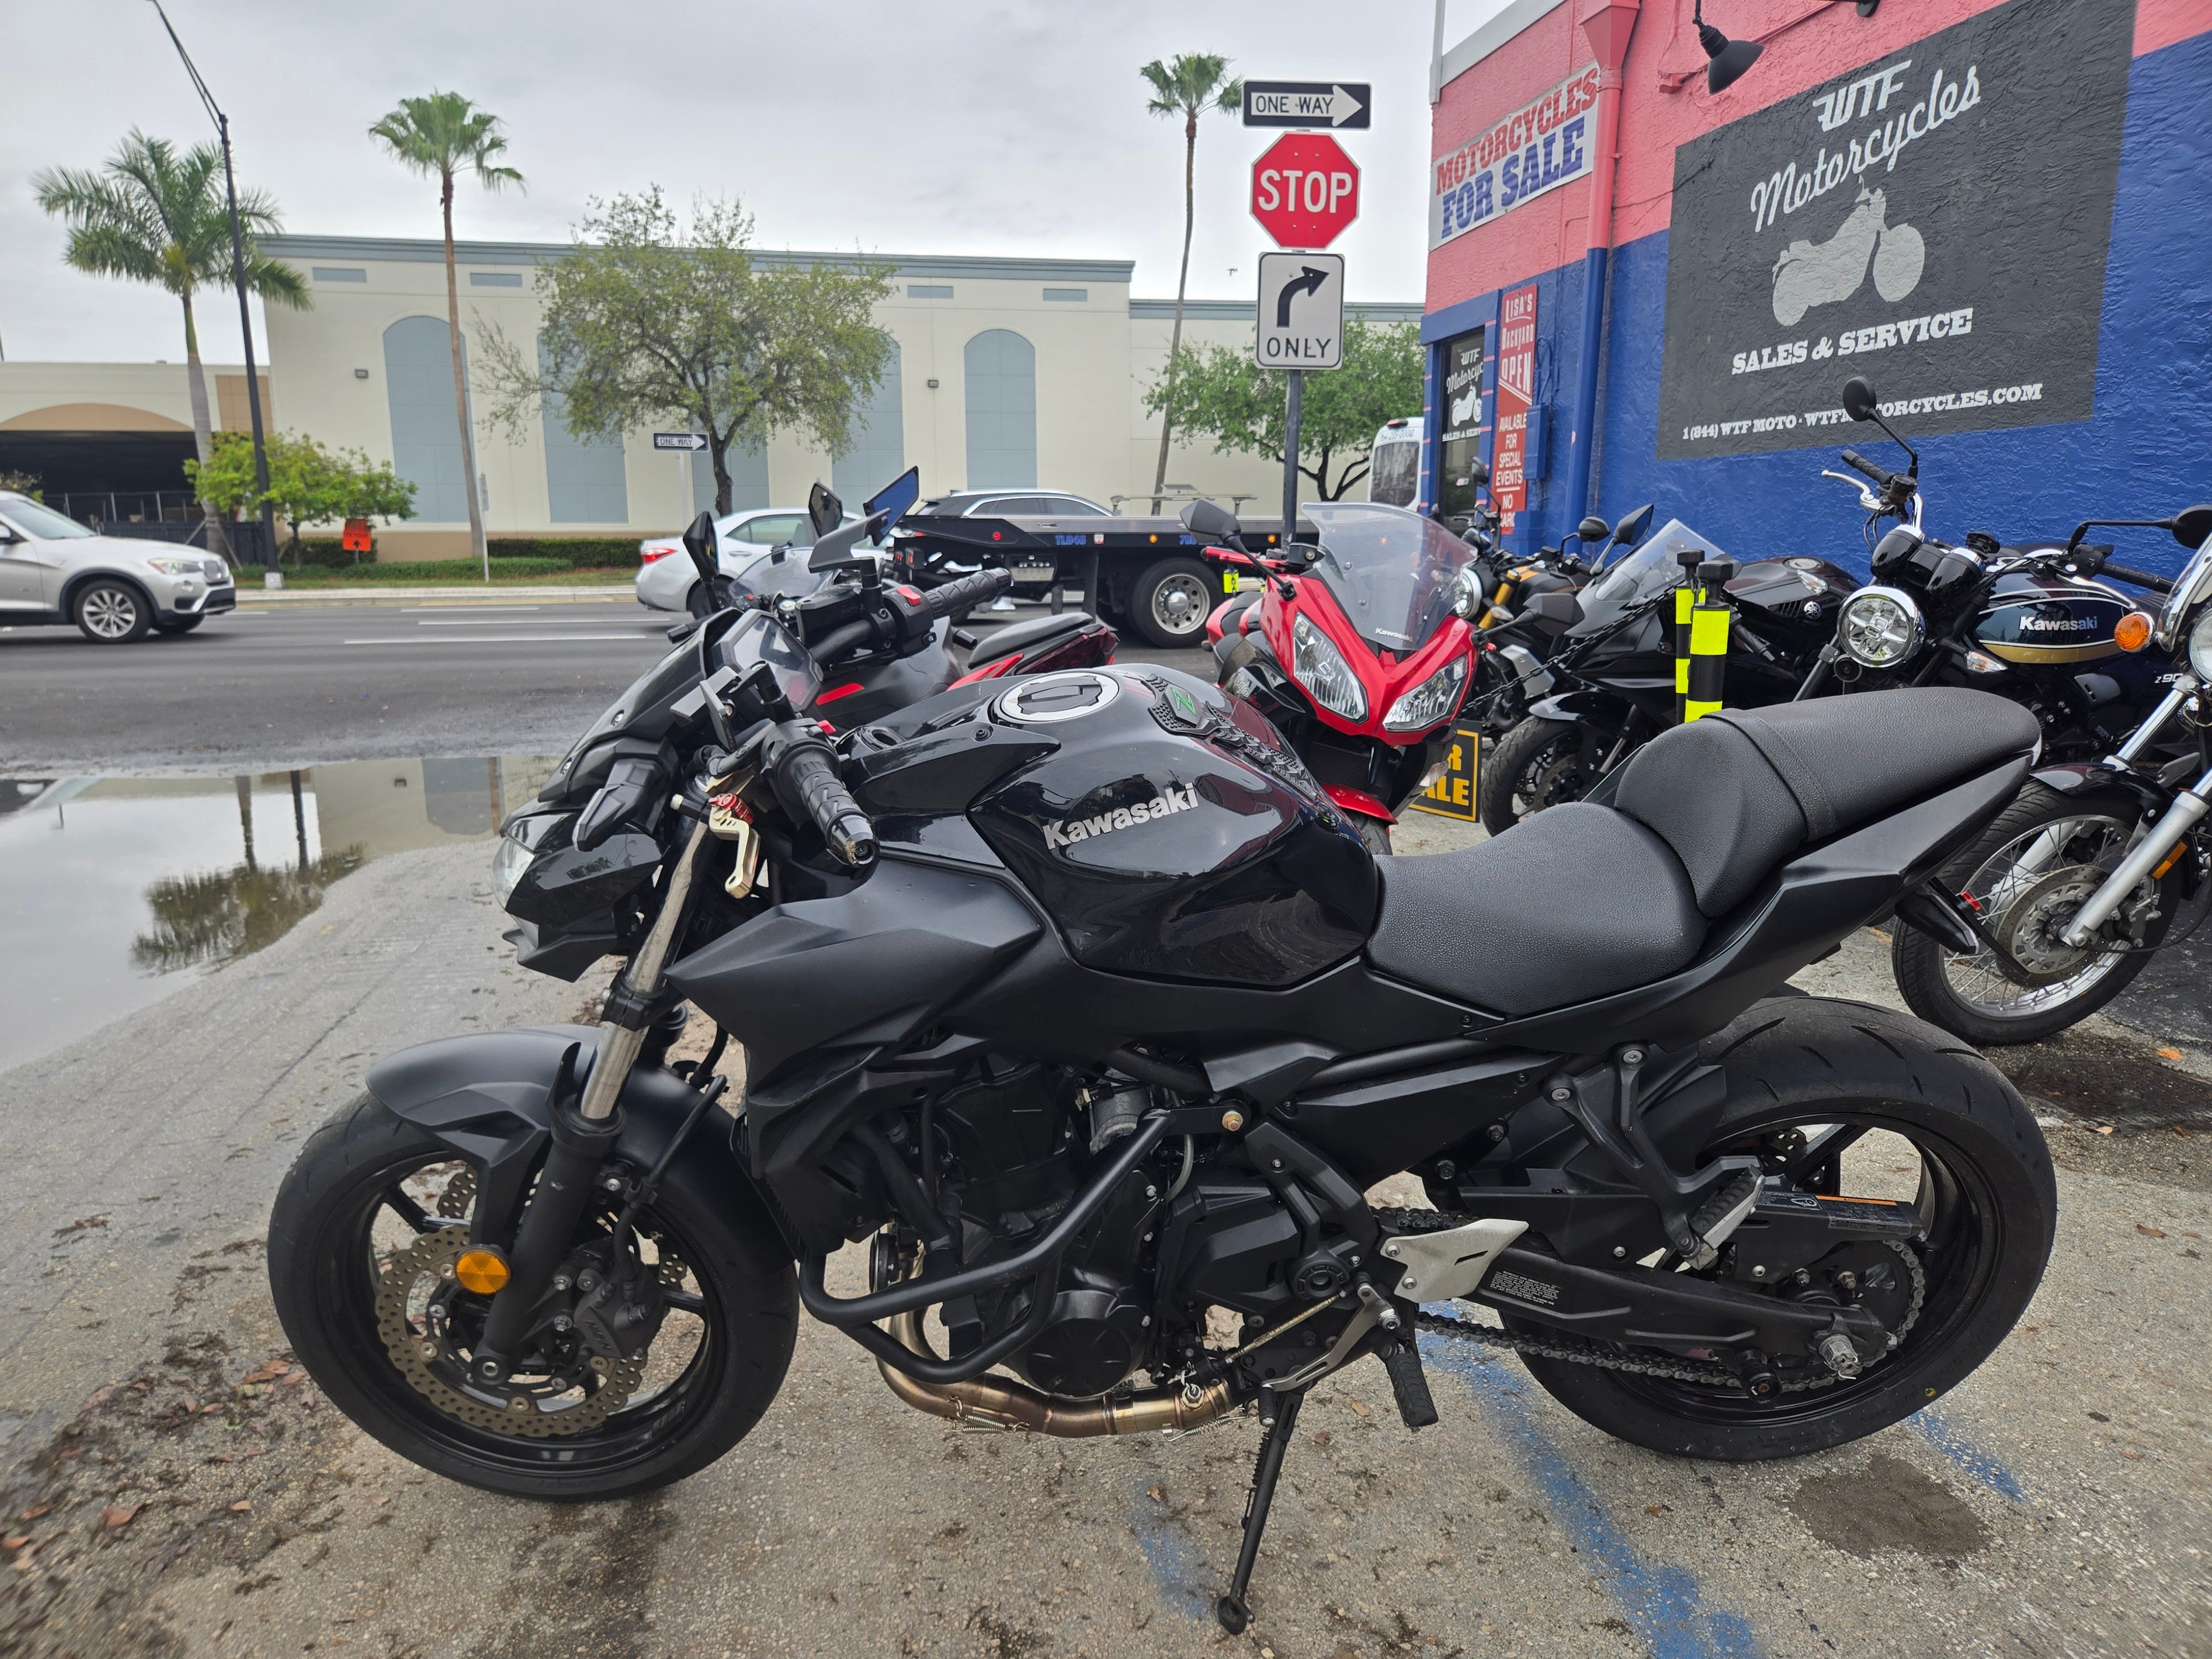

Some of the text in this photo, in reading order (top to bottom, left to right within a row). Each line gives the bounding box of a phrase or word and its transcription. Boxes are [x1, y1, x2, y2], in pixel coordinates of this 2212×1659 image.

[1256, 96, 1333, 114] ONE WAY
[1812, 60, 1912, 132] WTF
[1436, 68, 1597, 196] MOTORCYCLES
[1750, 65, 1980, 233] Motorcycles
[1442, 116, 1585, 239] FOR SALE
[1258, 169, 1353, 213] STOP
[1505, 293, 1532, 323] LISA'S
[1267, 337, 1332, 358] ONLY
[1731, 307, 1973, 375] SALES & SERVICE
[1458, 348, 1481, 365] WTF
[1501, 352, 1531, 394] OPEN
[1499, 413, 1527, 432] AVAILABLE
[1682, 426, 1689, 440] 1
[1690, 424, 1719, 441] (844)
[1720, 420, 1752, 435] WTF
[1752, 415, 1797, 432] MOTO
[1442, 431, 1460, 442] SALES
[1505, 434, 1517, 449] FOR
[1499, 451, 1521, 468] SPECIAL
[1496, 469, 1523, 486] EVENTS
[1503, 494, 1513, 509] NO
[2019, 616, 2098, 631] Kawasaki
[1375, 628, 1412, 642] Kawasaki
[1042, 782, 1199, 850] Kawasaki
